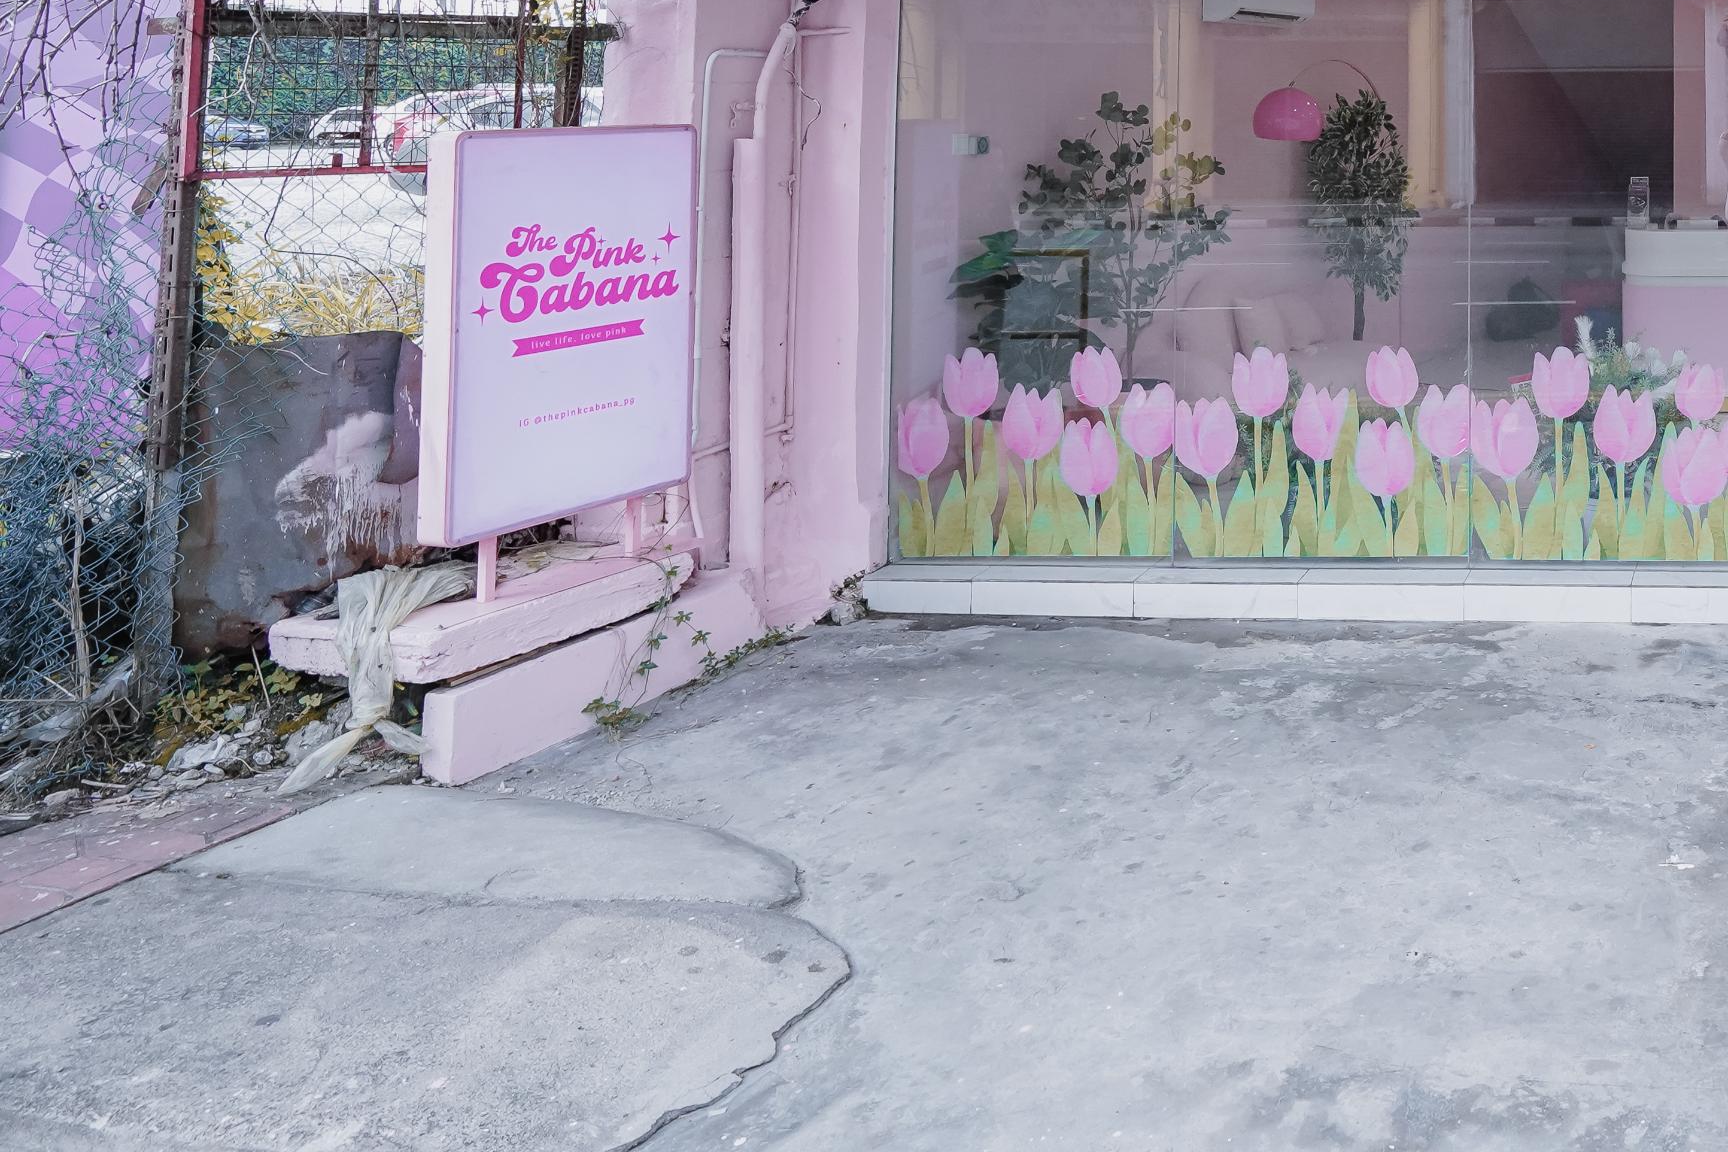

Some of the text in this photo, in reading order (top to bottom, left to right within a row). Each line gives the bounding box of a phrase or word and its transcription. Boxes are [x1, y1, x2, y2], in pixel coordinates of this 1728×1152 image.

[506, 224, 646, 277] The Pink
[480, 263, 680, 323] Cabana
[531, 339, 551, 351] live
[581, 331, 602, 343] love
[605, 326, 627, 340] pink
[534, 397, 636, 425] @thepinkcabana_pg
